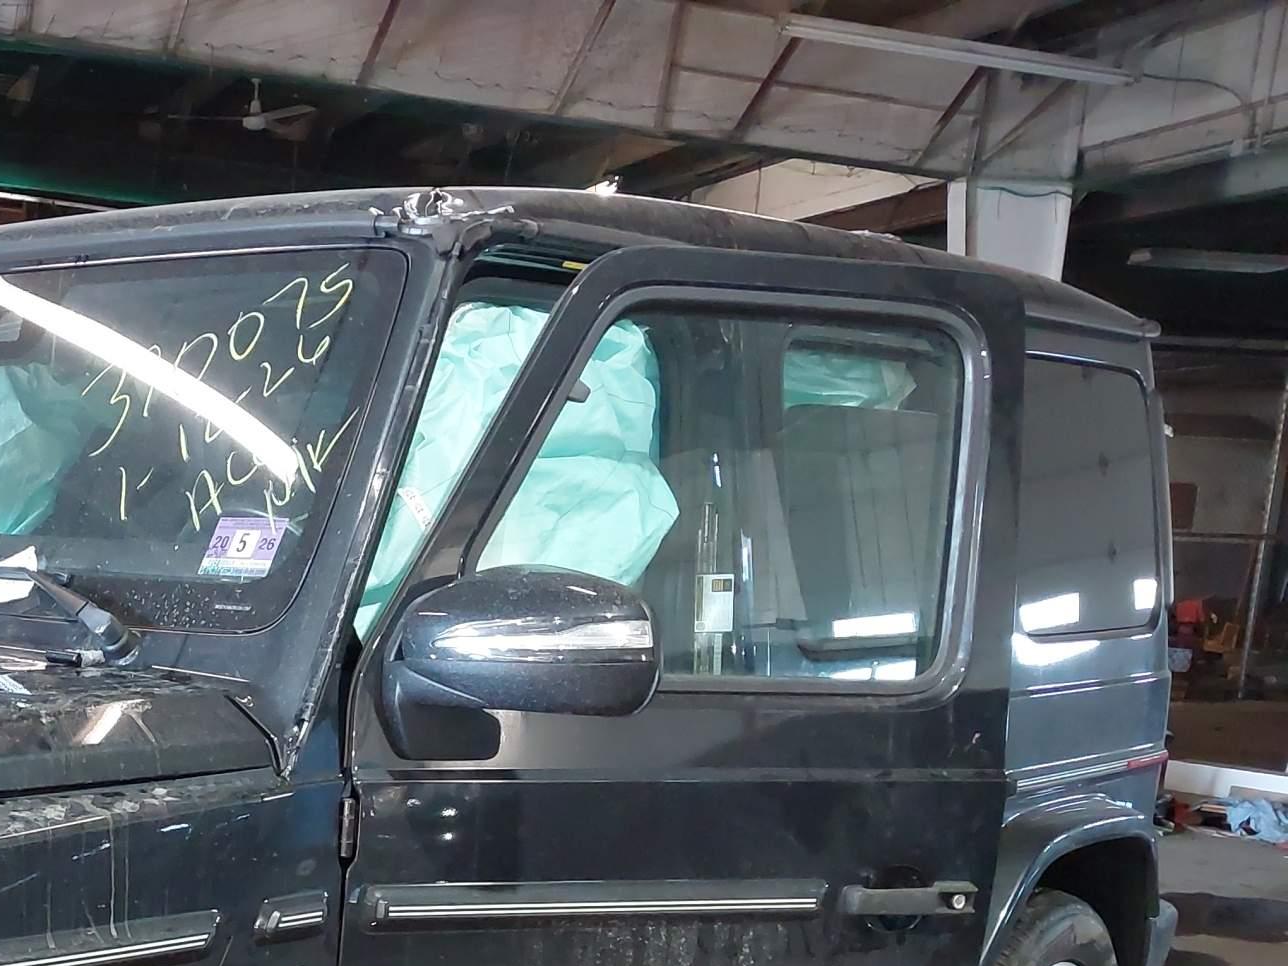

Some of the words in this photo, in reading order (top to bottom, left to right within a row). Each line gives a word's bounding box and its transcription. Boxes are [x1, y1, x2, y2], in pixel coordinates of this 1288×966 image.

[212, 535, 231, 551] 20
[236, 532, 251, 553] 5
[258, 537, 277, 552] 26
